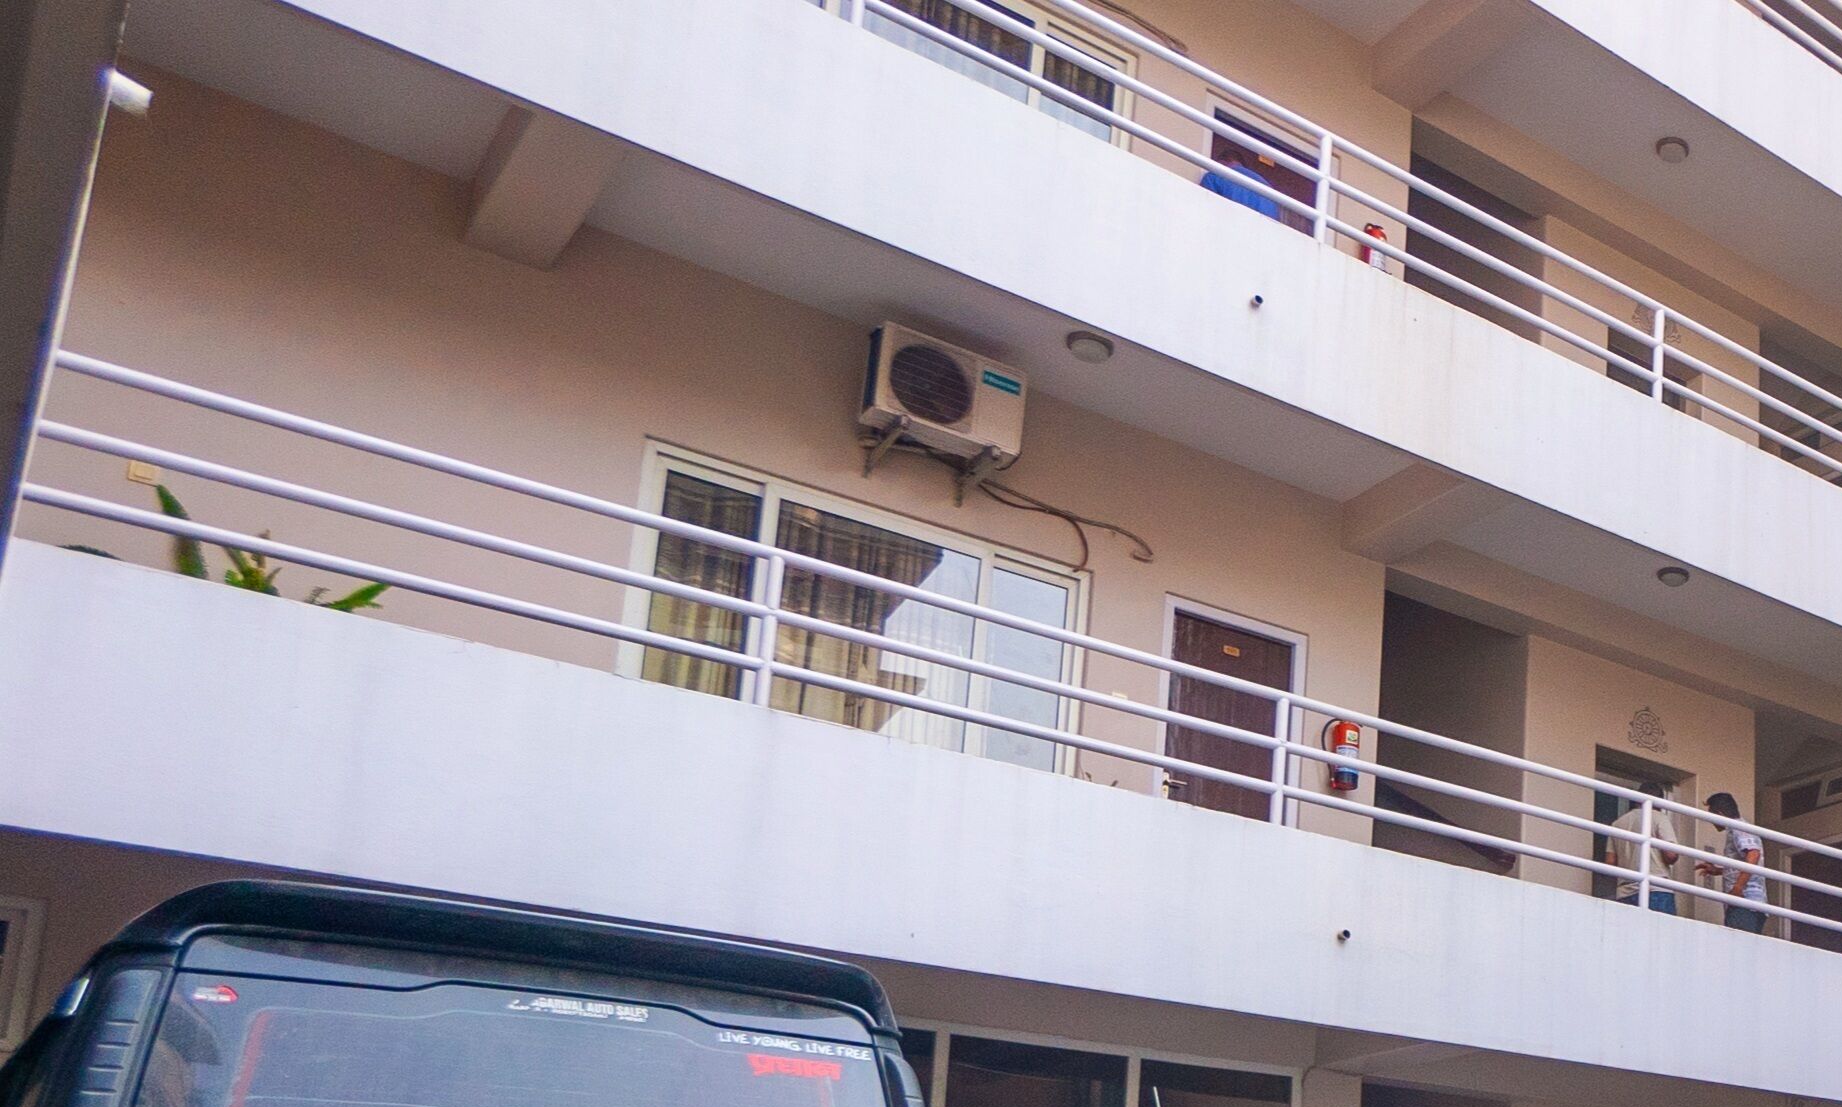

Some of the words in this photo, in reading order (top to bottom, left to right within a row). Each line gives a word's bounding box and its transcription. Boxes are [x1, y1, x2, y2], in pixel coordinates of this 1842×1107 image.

[616, 1005, 649, 1019] SALES
[719, 1032, 749, 1043] LIVE
[805, 1042, 834, 1056] LIVE
[836, 1046, 872, 1061] FREE
